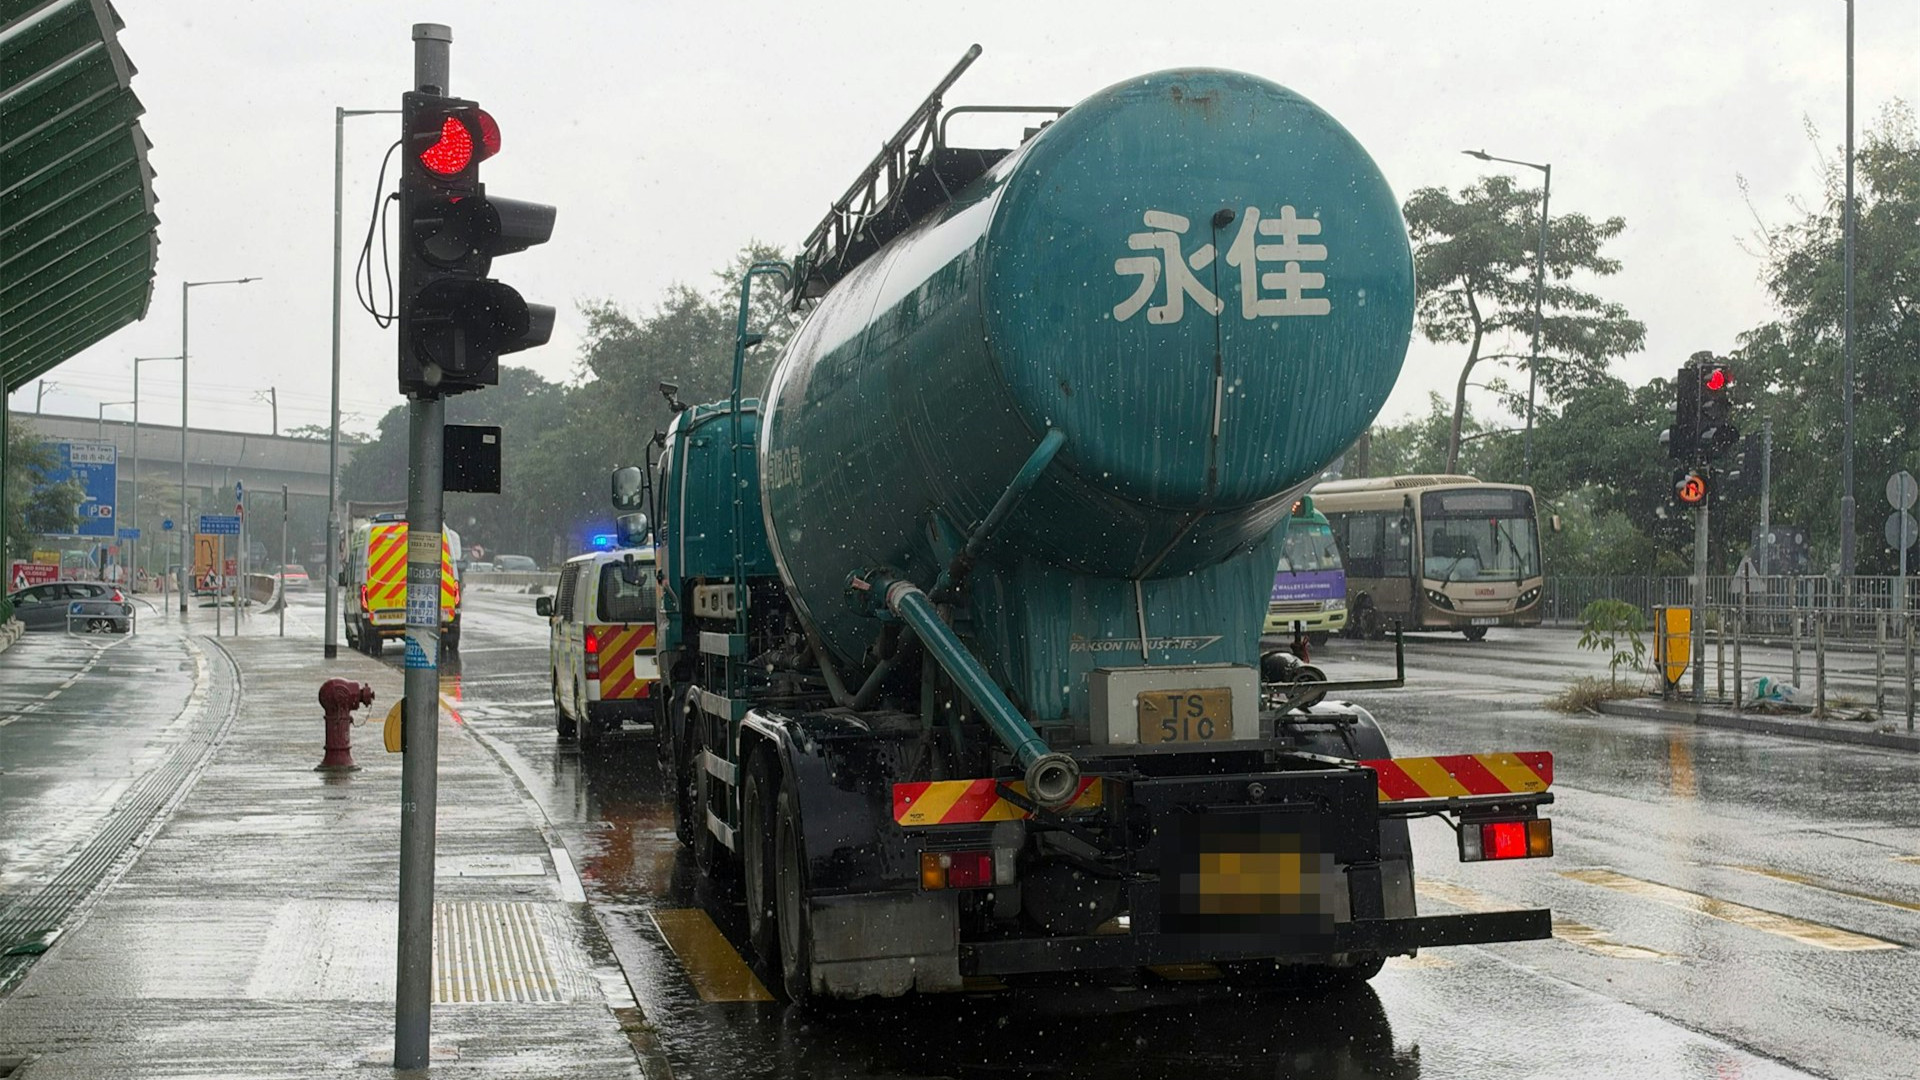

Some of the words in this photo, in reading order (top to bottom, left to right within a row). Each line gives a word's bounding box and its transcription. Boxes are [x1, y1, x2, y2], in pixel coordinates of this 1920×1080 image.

[1113, 205, 1331, 324] 永佳
[1168, 695, 1203, 717] TS
[1161, 717, 1214, 742] 510
